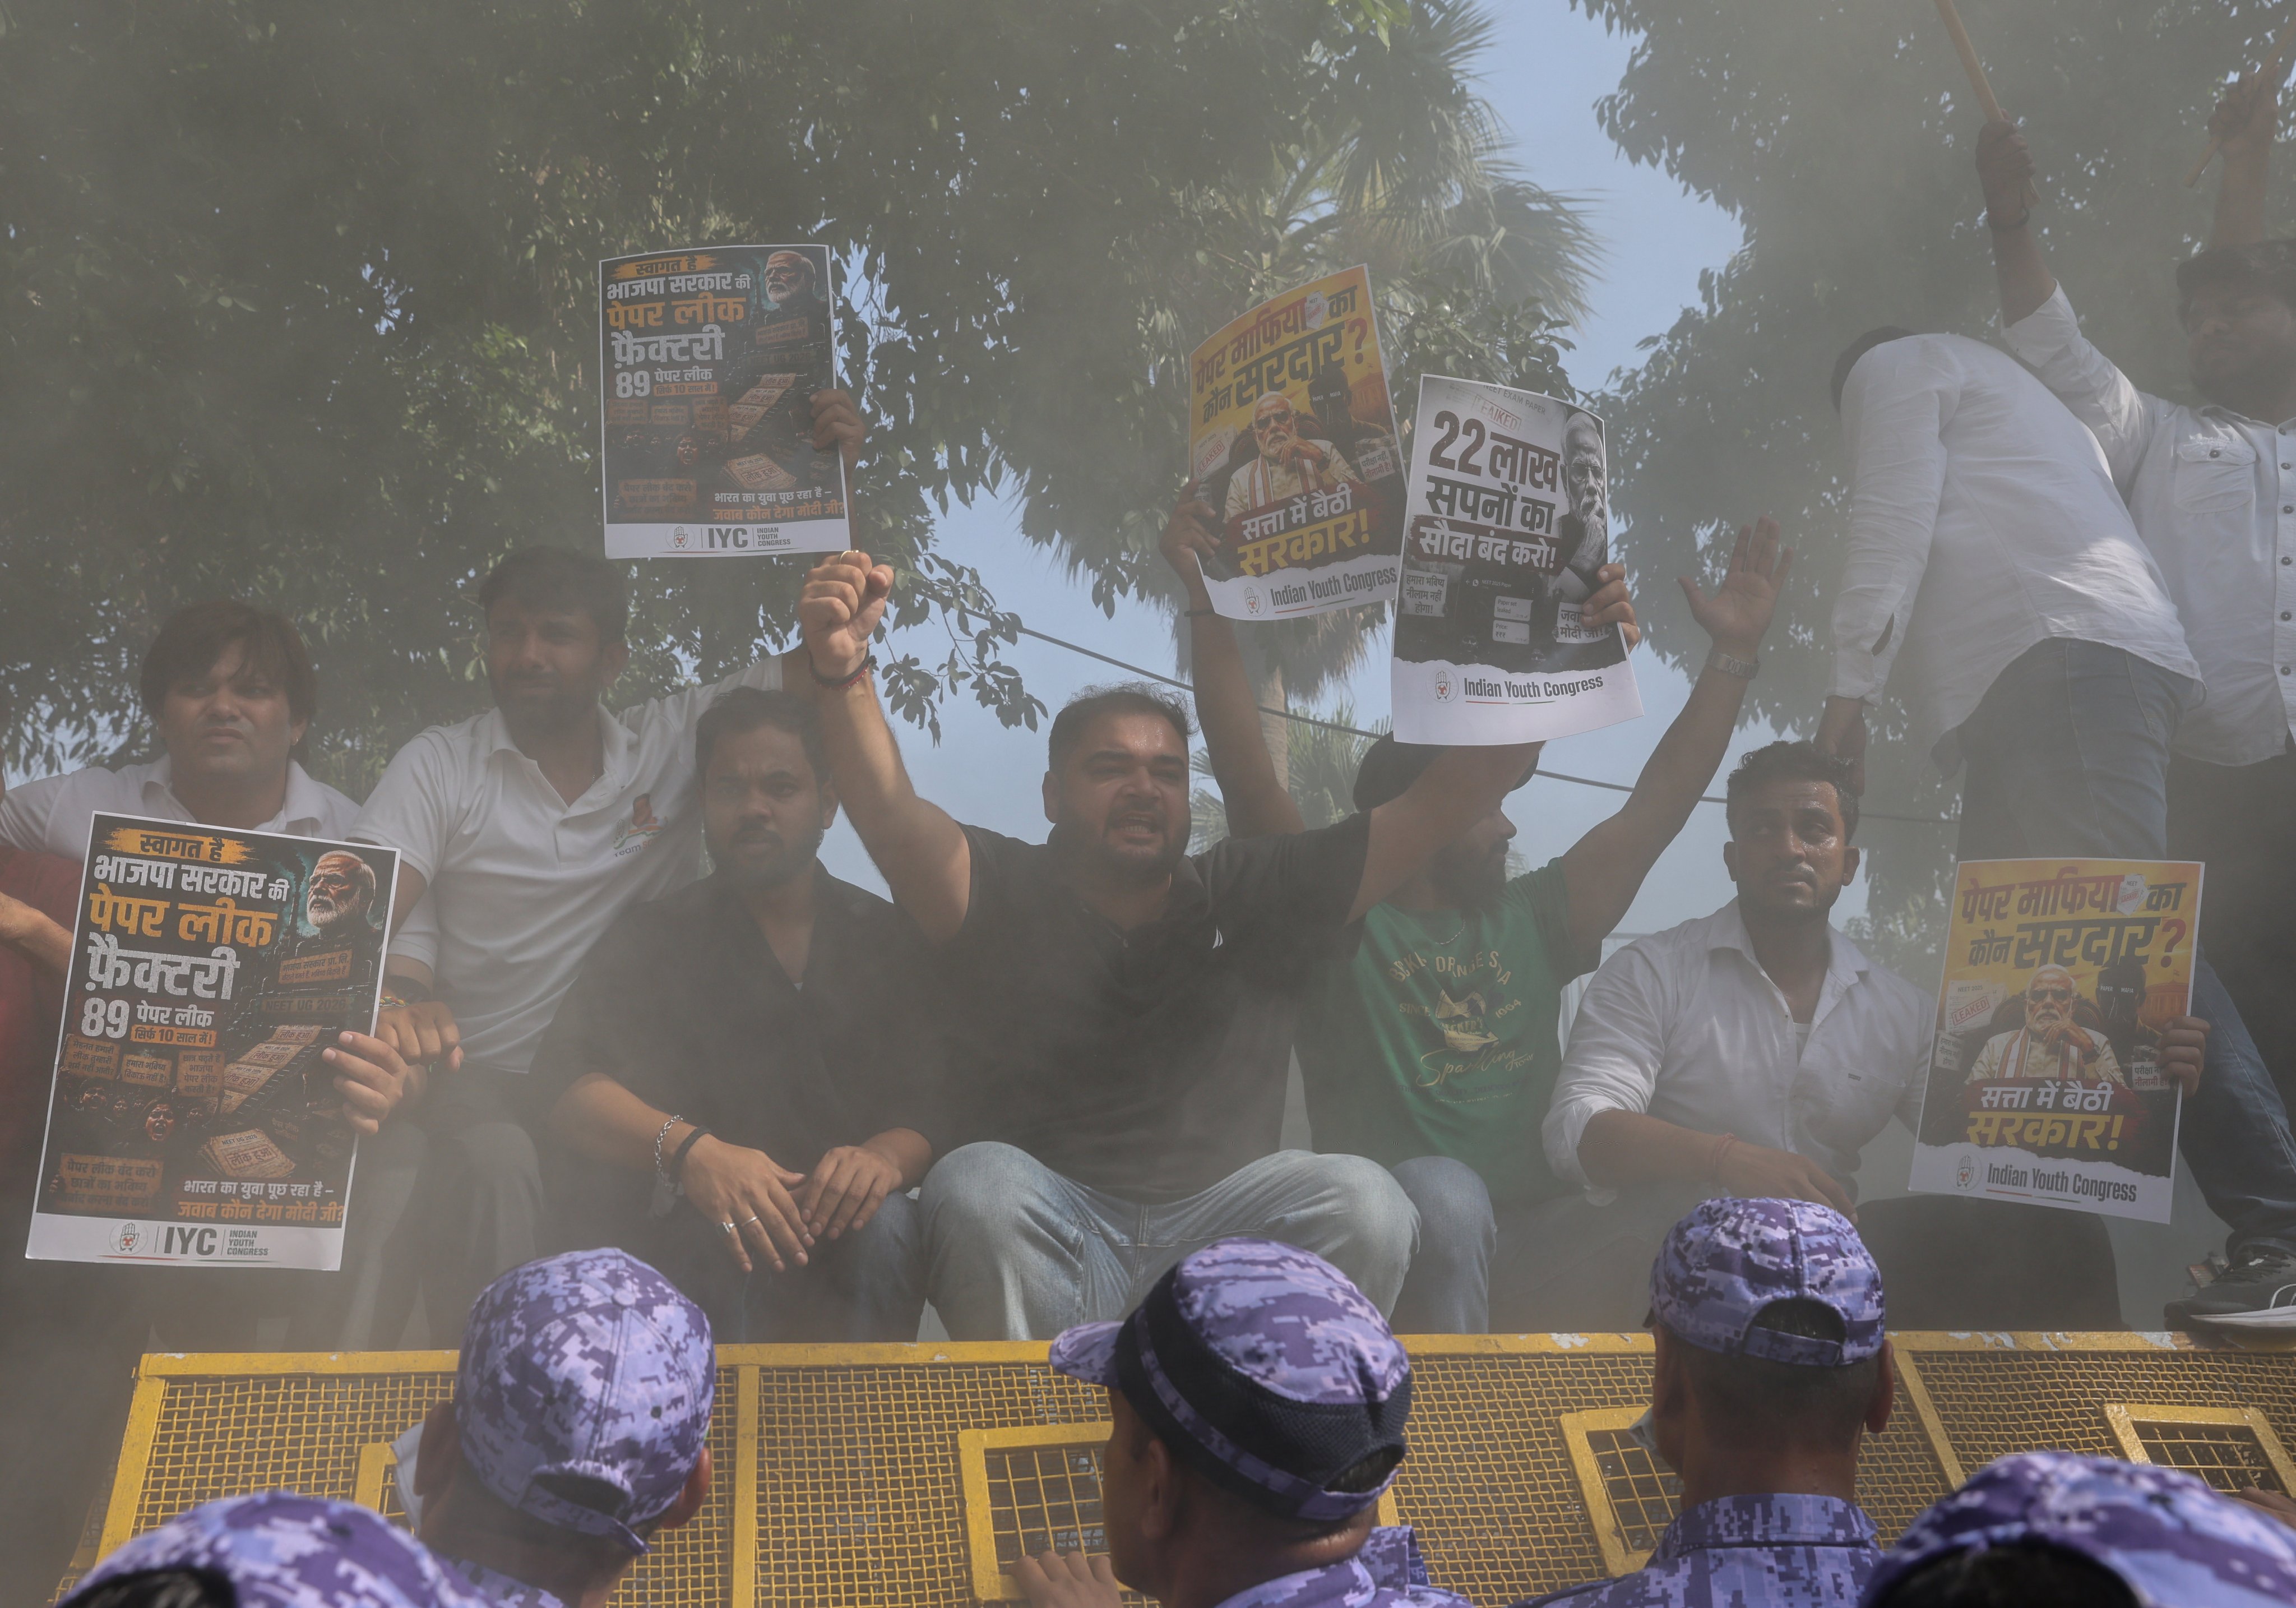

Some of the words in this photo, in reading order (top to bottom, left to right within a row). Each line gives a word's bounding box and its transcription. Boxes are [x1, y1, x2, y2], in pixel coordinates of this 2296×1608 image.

[636, 260, 681, 275] स्वागत
[684, 255, 697, 270] है
[607, 277, 666, 299] भाजपा
[668, 272, 733, 292] सरकार
[735, 275, 751, 289] की
[607, 299, 666, 330] पेपर
[672, 292, 746, 324] लीक
[611, 324, 725, 369] फ़ैक्टरी
[1195, 344, 1227, 394] पेपर
[1230, 297, 1307, 364] माफिया
[1328, 285, 1357, 318] का
[615, 370, 650, 398] 89
[654, 368, 681, 382] पेपर
[683, 366, 713, 381] लीक
[656, 385, 672, 394] सिर्फ
[674, 385, 685, 393] 10
[1203, 381, 1232, 424] कौन
[1503, 389, 1523, 404] EXAM
[1525, 400, 1545, 415] PAPER
[1199, 443, 1222, 473] LEAKED
[1361, 456, 1376, 468] परीक्षा
[1429, 410, 1485, 477] 22
[1489, 431, 1561, 493] लाख
[713, 509, 743, 520] जवाब
[746, 505, 771, 520] कौन
[773, 505, 794, 519] देगा
[797, 500, 822, 516] मोदी
[715, 493, 739, 502] भारत
[742, 493, 755, 502] का
[758, 493, 776, 505] युवा
[779, 492, 794, 504] पूछ
[797, 490, 812, 500] रहा
[1426, 474, 1518, 528] सपनों
[1520, 496, 1556, 534] का
[1242, 509, 1285, 540] सत्ता
[1290, 496, 1309, 524] में
[1311, 483, 1352, 517] बैठी
[709, 528, 748, 548] IYC
[1238, 509, 1370, 576] सरकार!
[1419, 519, 1475, 560] सौदा
[1477, 530, 1510, 566] बंद
[1512, 537, 1556, 569] करो!
[1270, 584, 1307, 606] Indian
[1307, 576, 1341, 600] Youth
[1345, 567, 1397, 593] Congress
[1406, 574, 1424, 585] हमारा
[1426, 575, 1445, 588] भविष्य
[1406, 586, 1428, 600] नीलाम
[1430, 590, 1442, 602] नहीं
[1415, 602, 1433, 613] होगा!
[1560, 624, 1581, 639] मोदी
[1464, 678, 1502, 698] Indian
[1504, 681, 1541, 698] Youth
[1544, 674, 1604, 697] Congress
[140, 833, 203, 860] स्वागत
[209, 838, 226, 860] है
[94, 854, 178, 890] भाजपा
[180, 866, 268, 899] सरकार
[268, 878, 290, 902] की
[1962, 877, 2016, 925] पेपर
[2017, 866, 2124, 917] माफिया
[2145, 882, 2187, 912] का
[89, 882, 170, 937] पेपर
[178, 897, 278, 949] लीक
[1968, 929, 2015, 967] कौन
[85, 931, 240, 1001] फ़ैक्टरी
[81, 997, 129, 1038] 89
[137, 1000, 172, 1024] पेपर
[174, 1004, 215, 1027] लीक
[266, 1000, 293, 1010] NEET
[297, 1000, 313, 1010] UG
[1954, 999, 1987, 1022] LEAKED
[95, 1042, 114, 1054] हमारी
[135, 1027, 156, 1040] सिर्फ
[159, 1028, 174, 1042] 10
[177, 1033, 196, 1043] साल
[198, 1031, 212, 1045] में!
[73, 1051, 89, 1060] लीक
[126, 1059, 145, 1068] हमारा
[270, 1053, 284, 1062] हुआ
[184, 1073, 199, 1083] पेपर
[201, 1074, 218, 1083] लीक
[1980, 1086, 2034, 1109] सत्ता
[2036, 1080, 2062, 1110] में
[2063, 1081, 2115, 1112] बैठी
[1966, 1110, 2125, 1152] सरकार!
[67, 1158, 88, 1174] पेपर
[92, 1162, 114, 1175] लीक
[136, 1166, 158, 1177] करो
[98, 1179, 112, 1190] का
[183, 1180, 218, 1194] भारत
[220, 1182, 238, 1194] का
[240, 1182, 265, 1200] युवा
[267, 1183, 289, 1200] पूछ
[290, 1184, 311, 1196] रहा
[313, 1180, 324, 1197] है
[1987, 1163, 2027, 1188] Indian
[2031, 1166, 2069, 1194] Youth
[2072, 1175, 2137, 1202] Congress
[177, 1201, 219, 1218] जवाब
[220, 1198, 254, 1219] कौन
[256, 1200, 284, 1221] देगा
[285, 1200, 318, 1221] मोदी
[319, 1201, 344, 1222] जी?
[164, 1226, 217, 1256] IYC
[229, 1229, 258, 1239] INDIAN
[226, 1247, 269, 1256] CONGRESS
